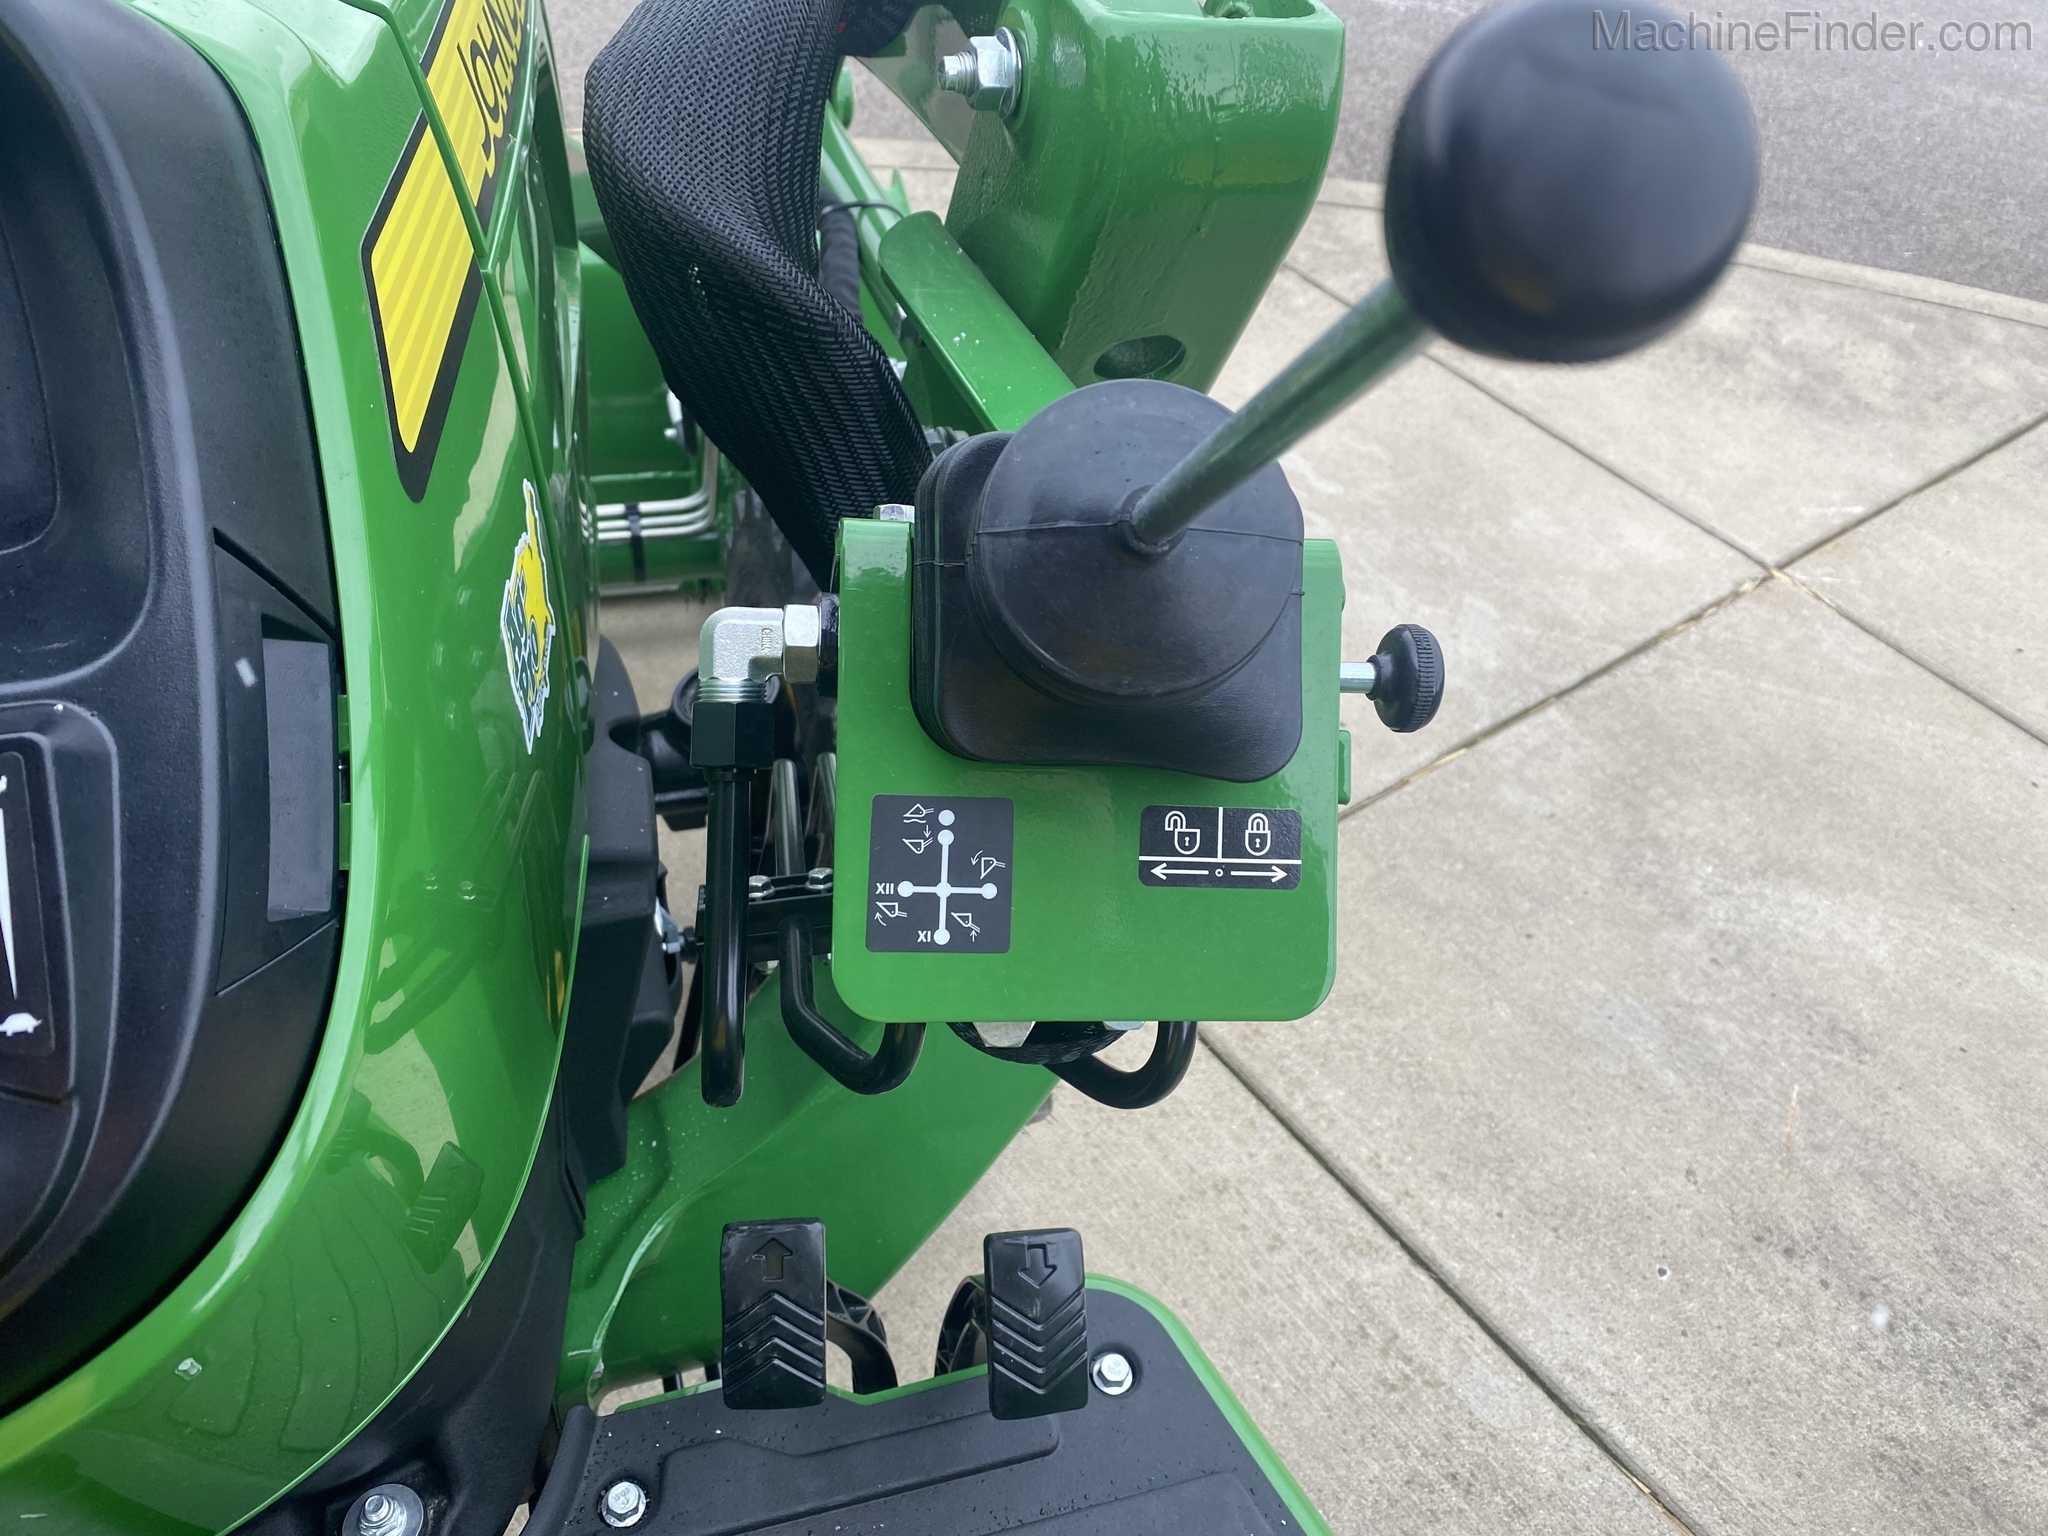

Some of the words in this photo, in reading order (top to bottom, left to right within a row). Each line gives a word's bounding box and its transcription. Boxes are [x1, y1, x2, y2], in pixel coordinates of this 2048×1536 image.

[761, 627, 773, 651] CHINA
[875, 882, 895, 895] XII
[917, 930, 932, 943] XI
